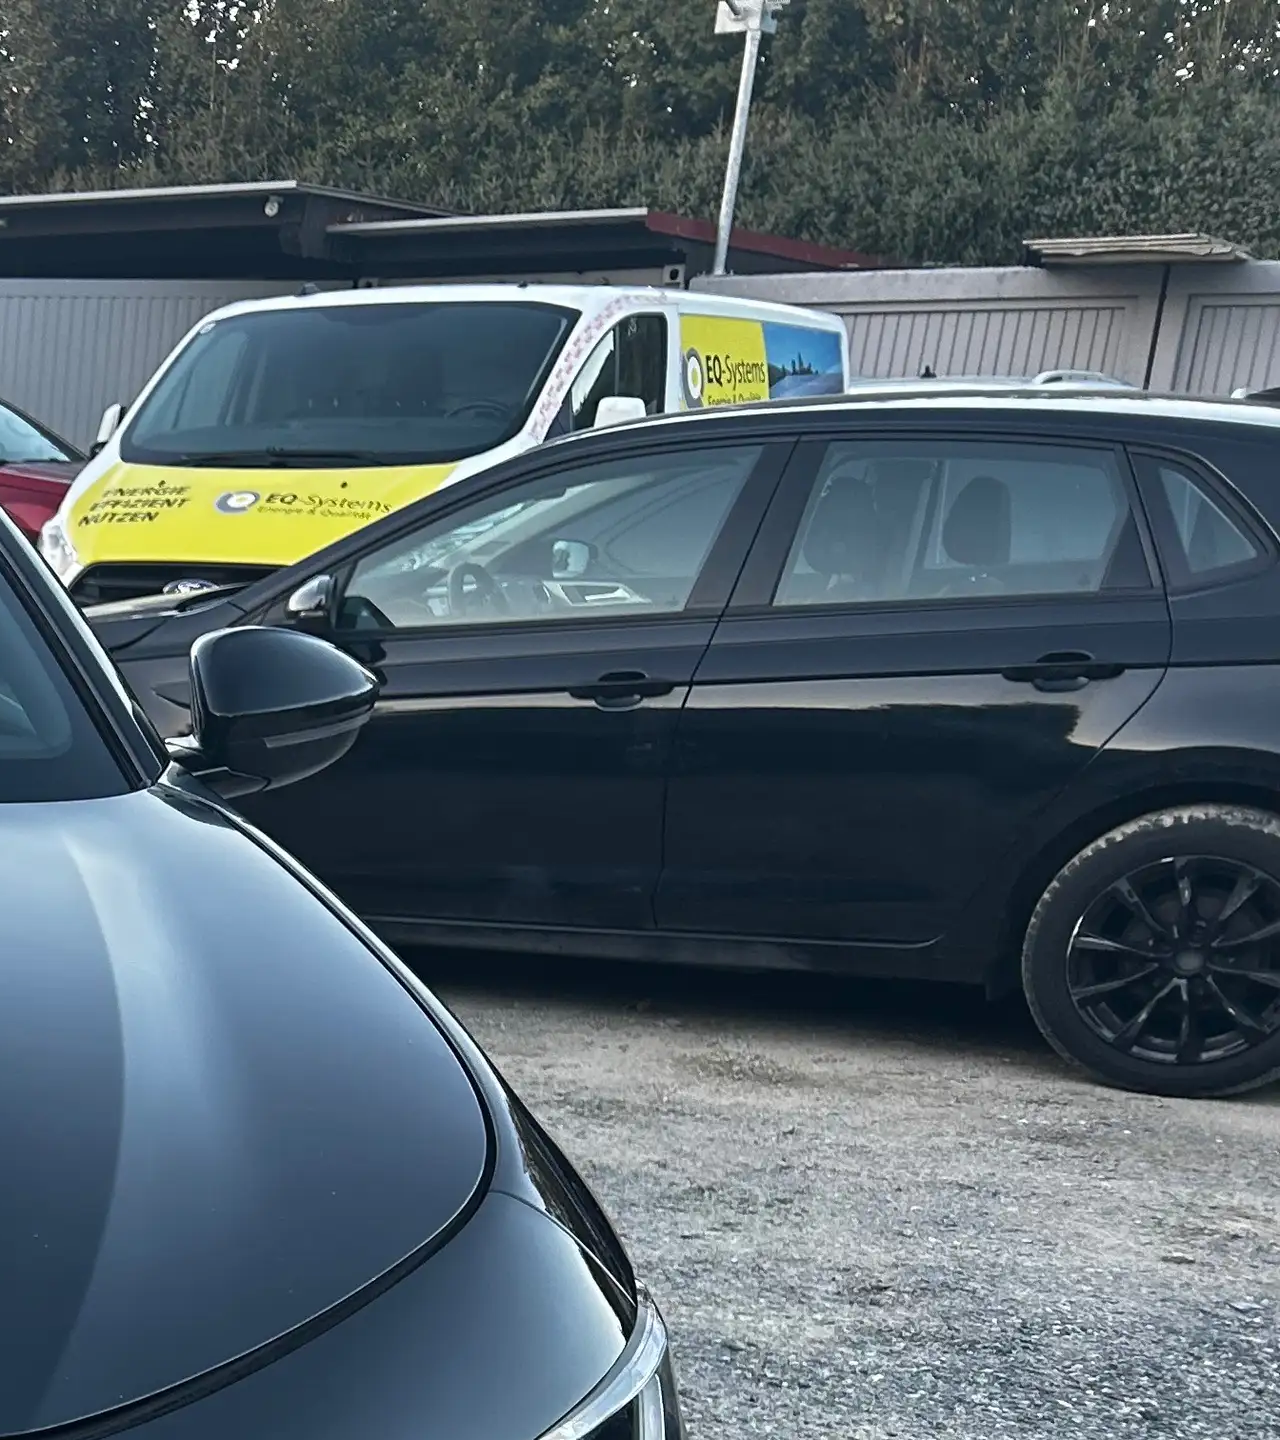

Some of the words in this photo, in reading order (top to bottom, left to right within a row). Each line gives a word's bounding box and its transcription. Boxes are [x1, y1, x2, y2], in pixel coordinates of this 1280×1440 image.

[706, 355, 766, 390] EQ-Systems
[265, 493, 393, 514] EQ-Systems
[78, 511, 159, 527] NUTZEN
